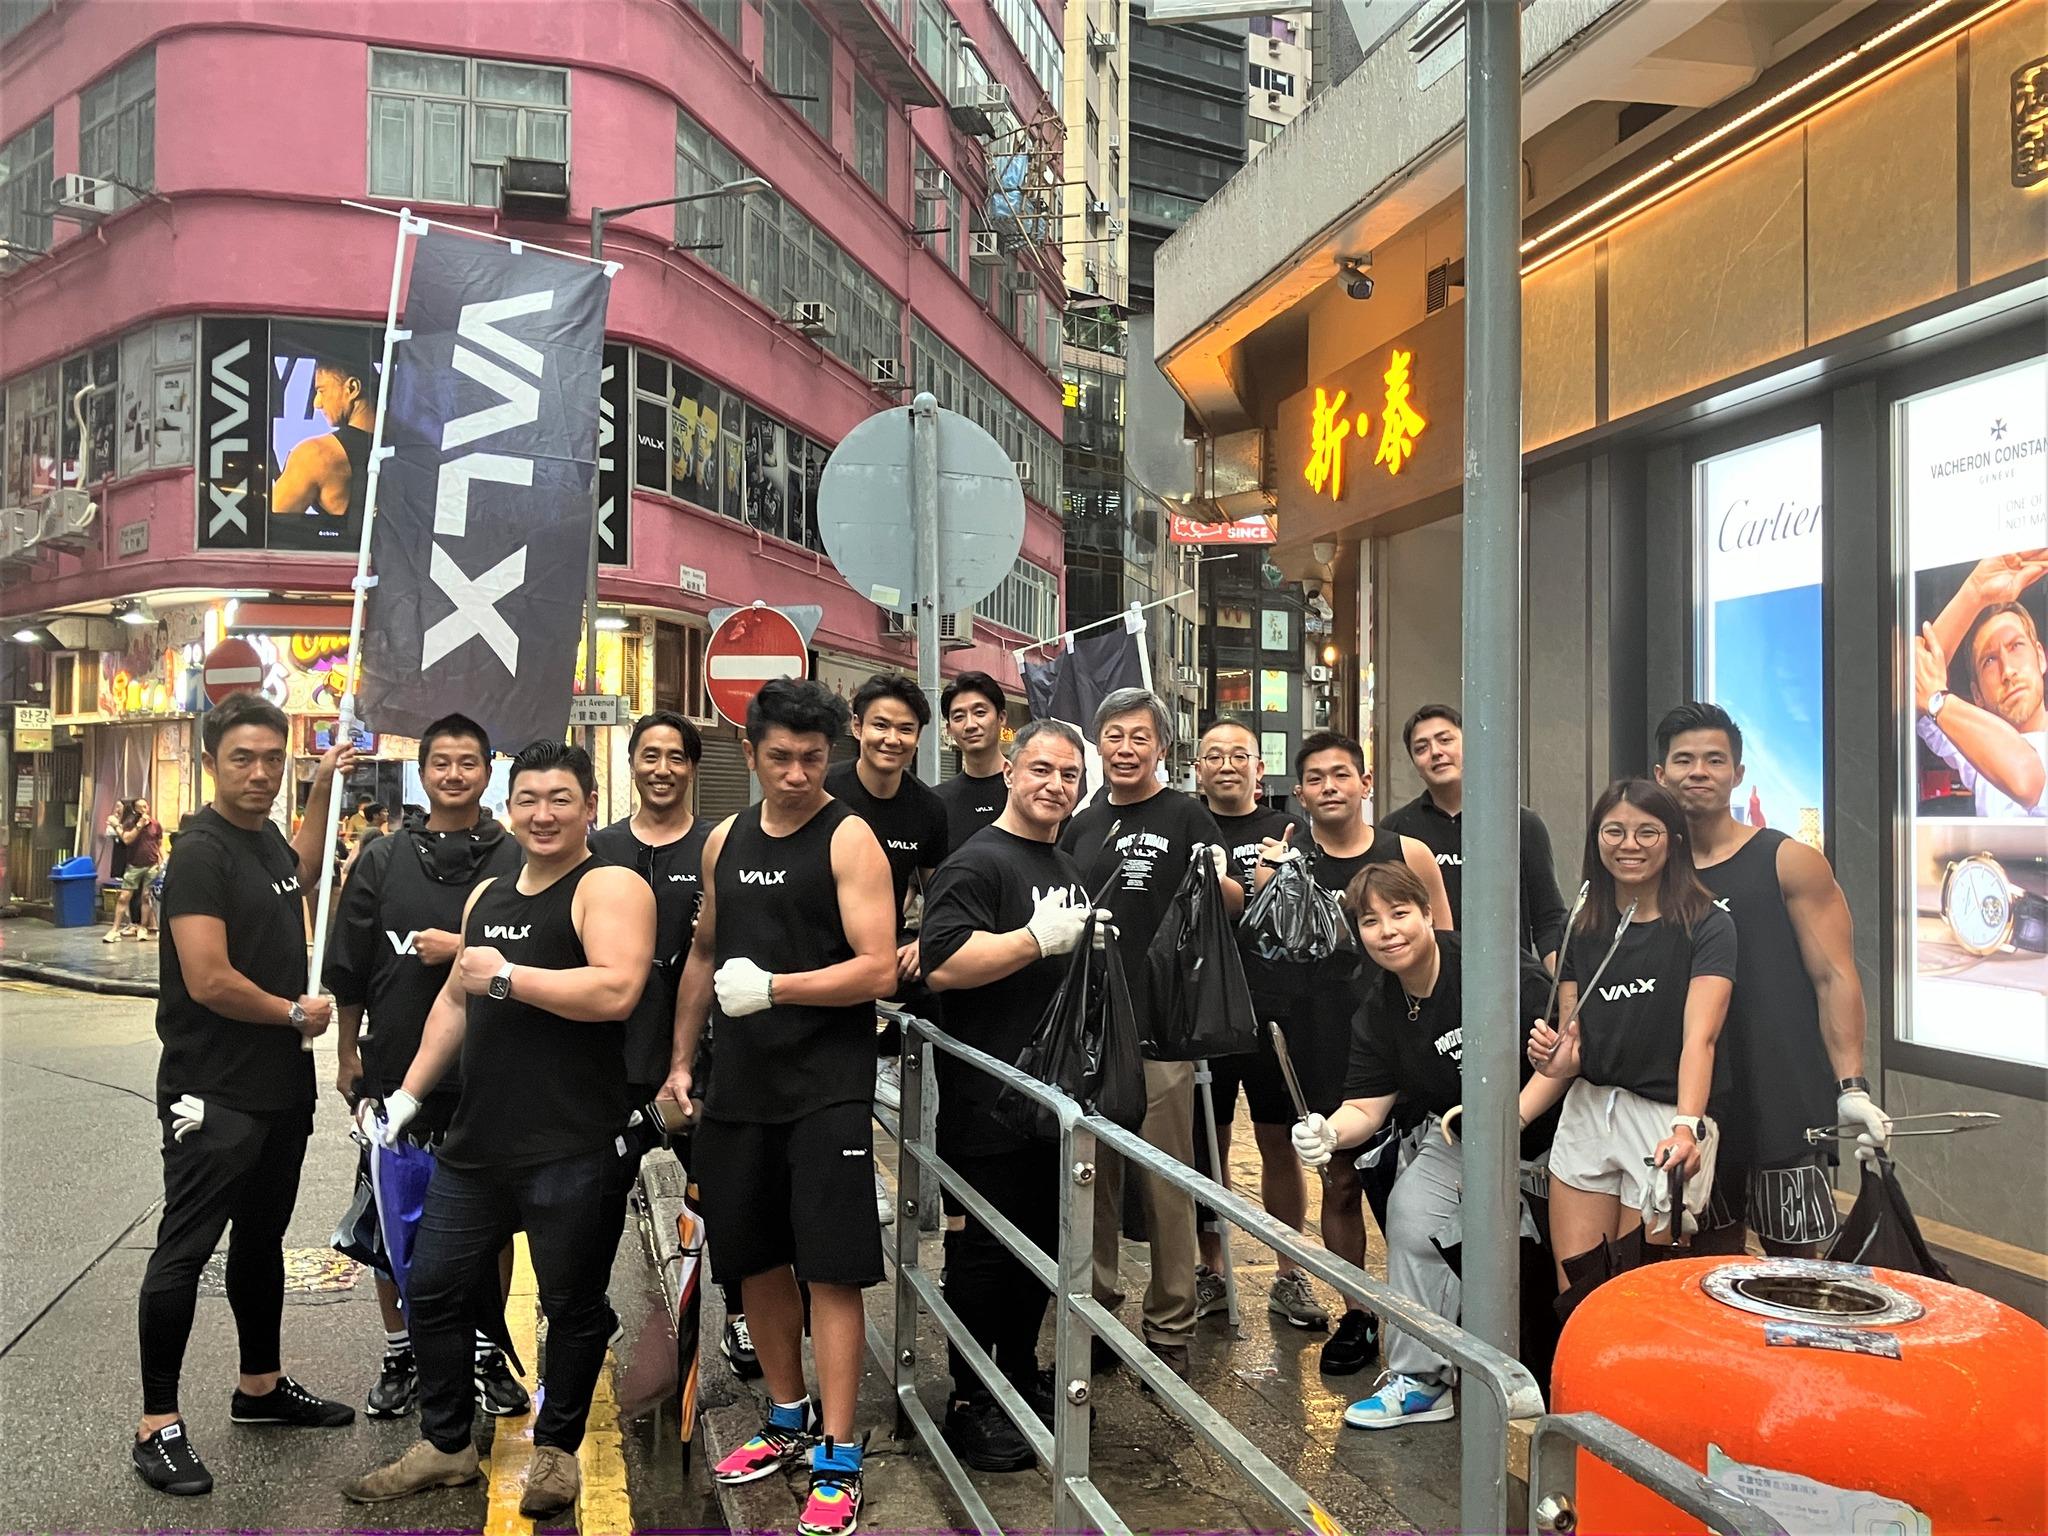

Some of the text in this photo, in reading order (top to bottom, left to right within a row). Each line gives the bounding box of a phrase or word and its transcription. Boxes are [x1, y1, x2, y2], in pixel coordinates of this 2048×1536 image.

[209, 339, 250, 539] VALX
[638, 434, 665, 451] VALX
[1931, 451, 1991, 479] VACHERON
[421, 290, 554, 678] VALX
[2005, 497, 2025, 513] ONE
[2005, 515, 2026, 530] NOT
[1227, 526, 1268, 538] SINCE
[588, 698, 615, 707] Avenue
[887, 839, 919, 850] VALX
[668, 874, 697, 882] VALX
[738, 869, 787, 886] VALX
[484, 924, 531, 940] VALX
[1599, 978, 1656, 1001] VALX
